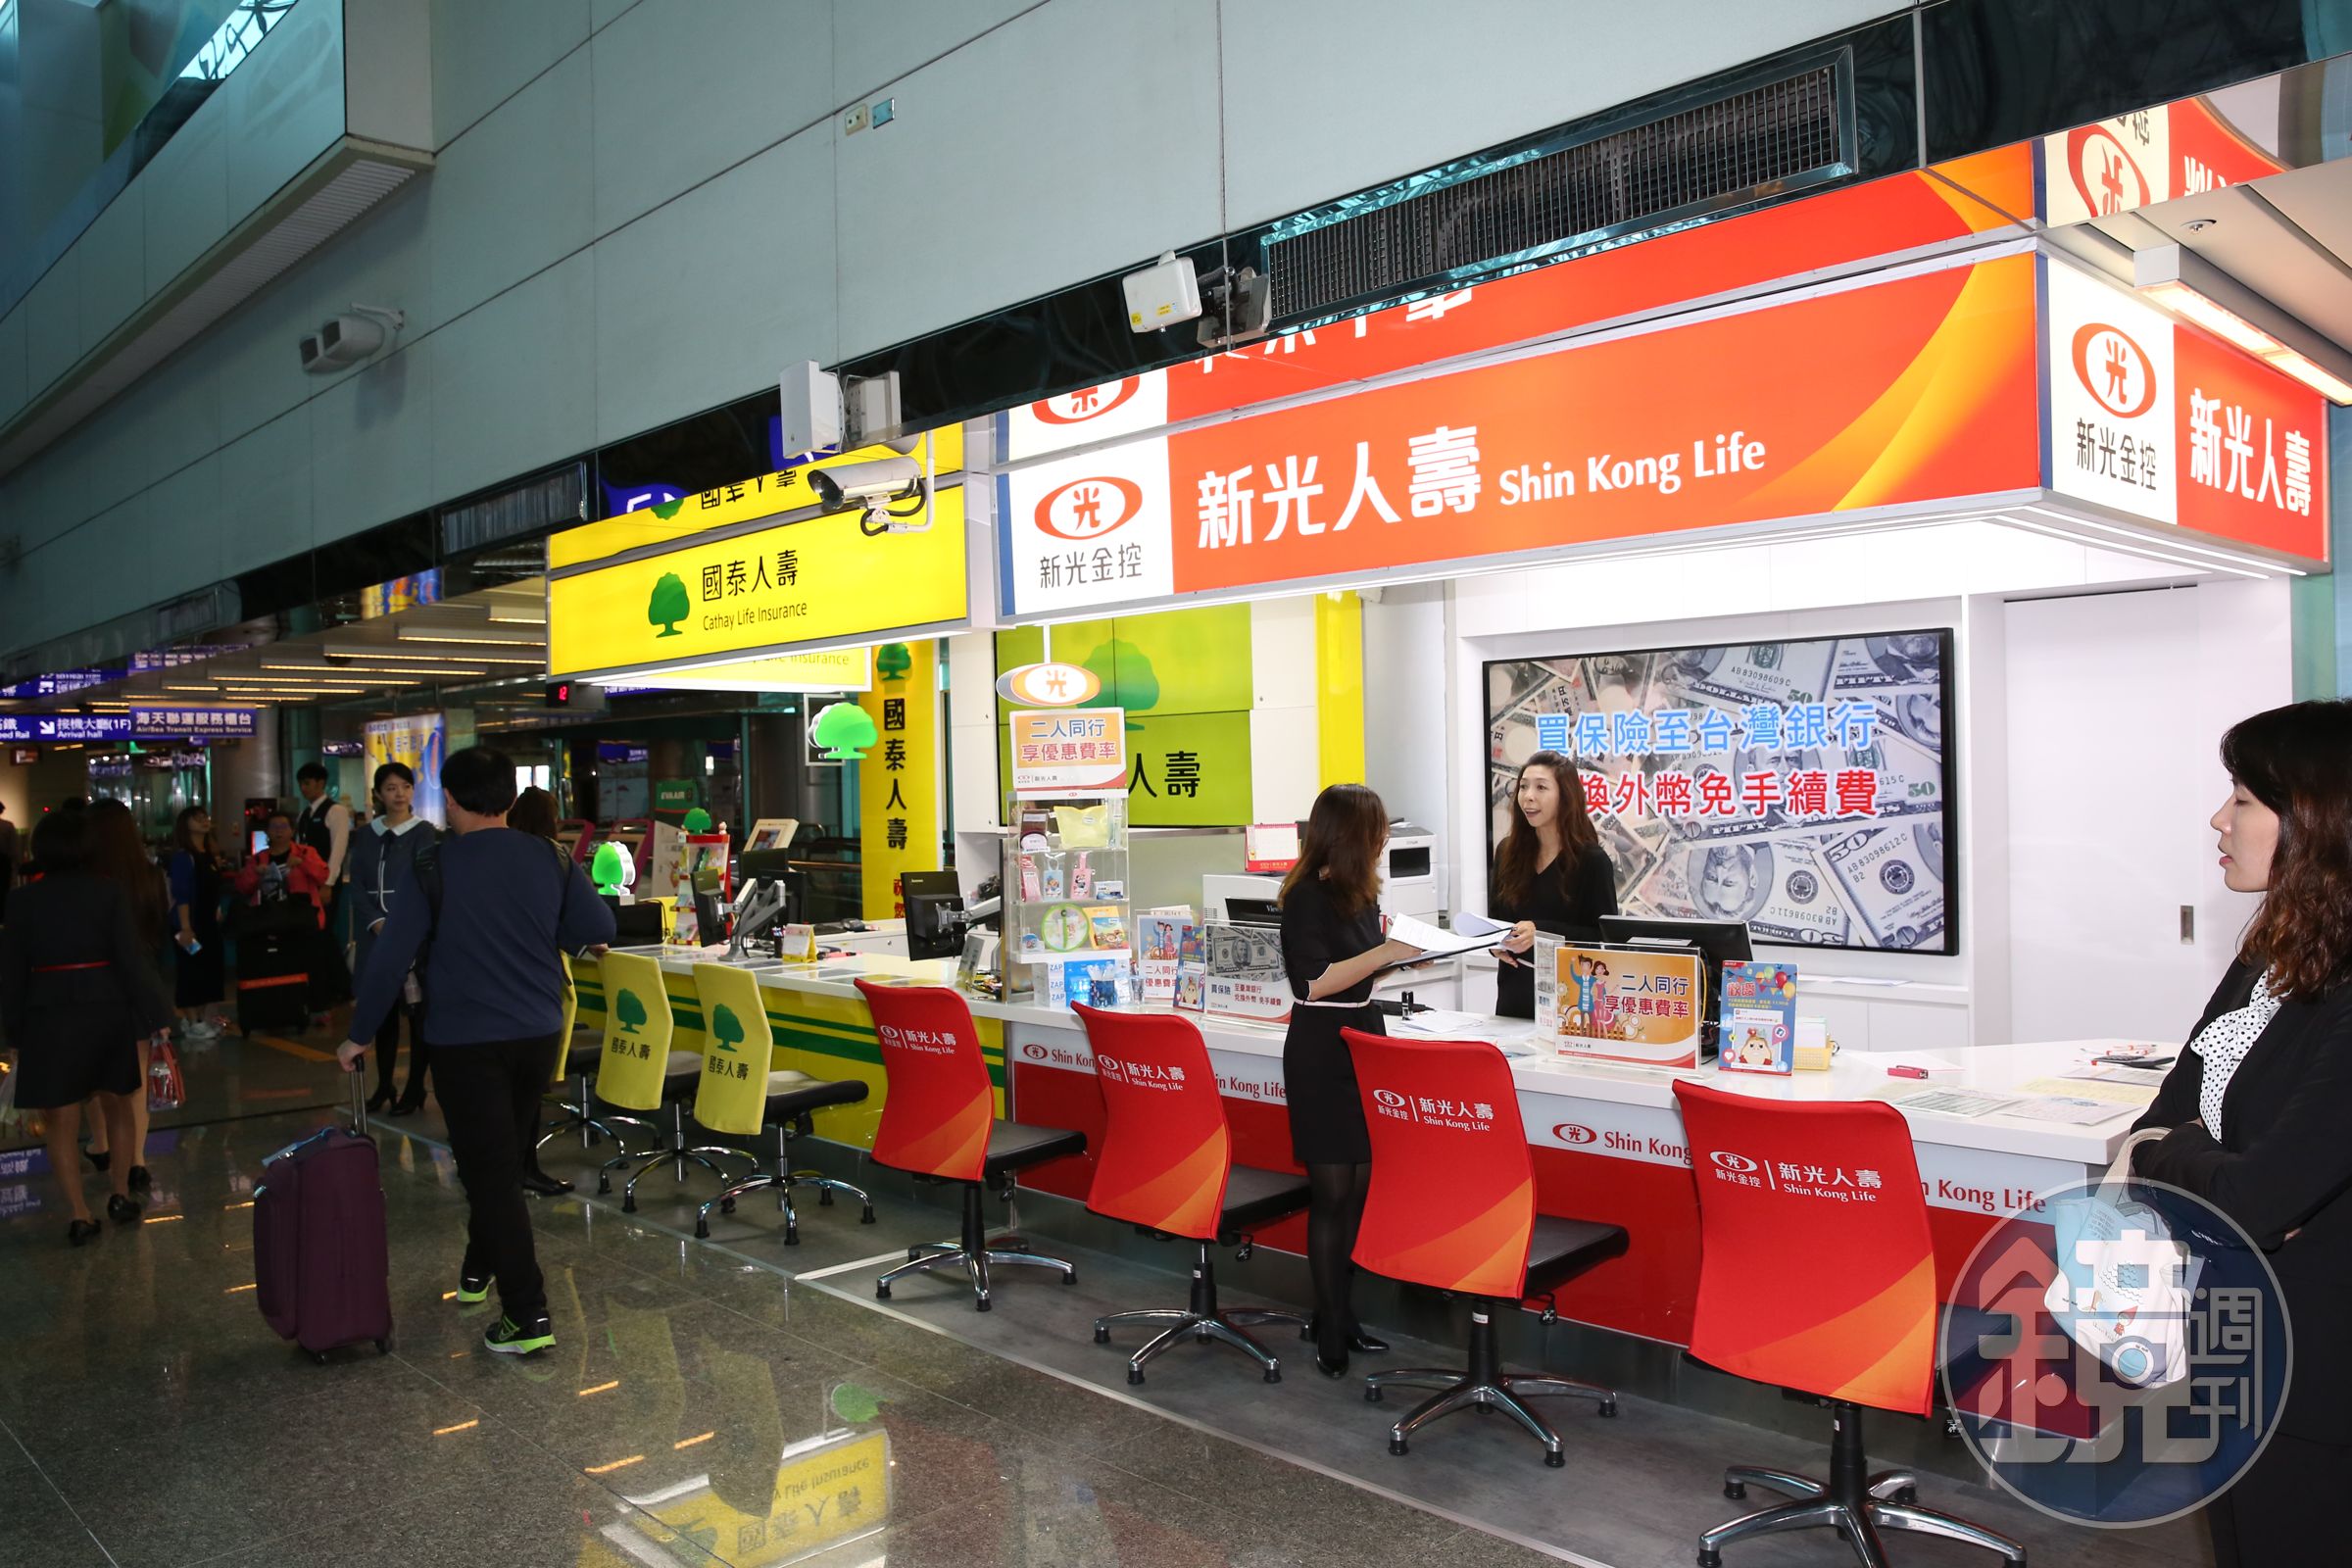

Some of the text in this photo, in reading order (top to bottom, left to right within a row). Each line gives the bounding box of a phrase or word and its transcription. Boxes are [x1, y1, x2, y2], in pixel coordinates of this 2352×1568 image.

[2077, 417, 2157, 491] 新光金控
[2189, 388, 2312, 516] 新光人壽
[1499, 430, 1766, 506] Shin Kong Life
[1198, 425, 1481, 549] 新光人壽
[1073, 486, 1101, 531] 光
[703, 550, 798, 602] 國泰人壽
[1040, 542, 1143, 589] 新光金控
[703, 602, 808, 631] Cathay Life Insurance
[1046, 670, 1067, 698] 光
[1031, 719, 1105, 738] 二人同行
[1538, 703, 1877, 755] 買保險至台灣銀行
[1021, 742, 1116, 762] 享優惠費率
[884, 698, 908, 851] 國泰人壽
[1128, 751, 1200, 798] 人壽
[1621, 974, 1689, 996] 二人同行
[1604, 995, 1690, 1019] 享優惠費率
[612, 1037, 651, 1060] 國泰人壽
[905, 1029, 956, 1046] 新光人壽
[924, 1045, 942, 1054] Kong
[942, 1046, 956, 1054] Life
[708, 1054, 749, 1081] 國泰人壽
[1051, 1049, 1098, 1070] Shin Kon
[1127, 1061, 1185, 1081] 新光人壽
[1132, 1078, 1184, 1091] Shin Kong Life
[1231, 1076, 1260, 1099] Kong
[1264, 1081, 1287, 1098] Life
[1378, 1104, 1408, 1121] 新光金控
[1419, 1097, 1494, 1120] 新光人壽
[1423, 1115, 1491, 1132] Shin Kong Life
[1604, 1131, 1693, 1165] Shin Kong
[1715, 1168, 1762, 1189] 新光金控
[1778, 1162, 1882, 1190] 新光人壽
[1784, 1183, 1877, 1202] Shin Kong Life
[1938, 1179, 1995, 1212] Kong
[2005, 1188, 2047, 1214] Life
